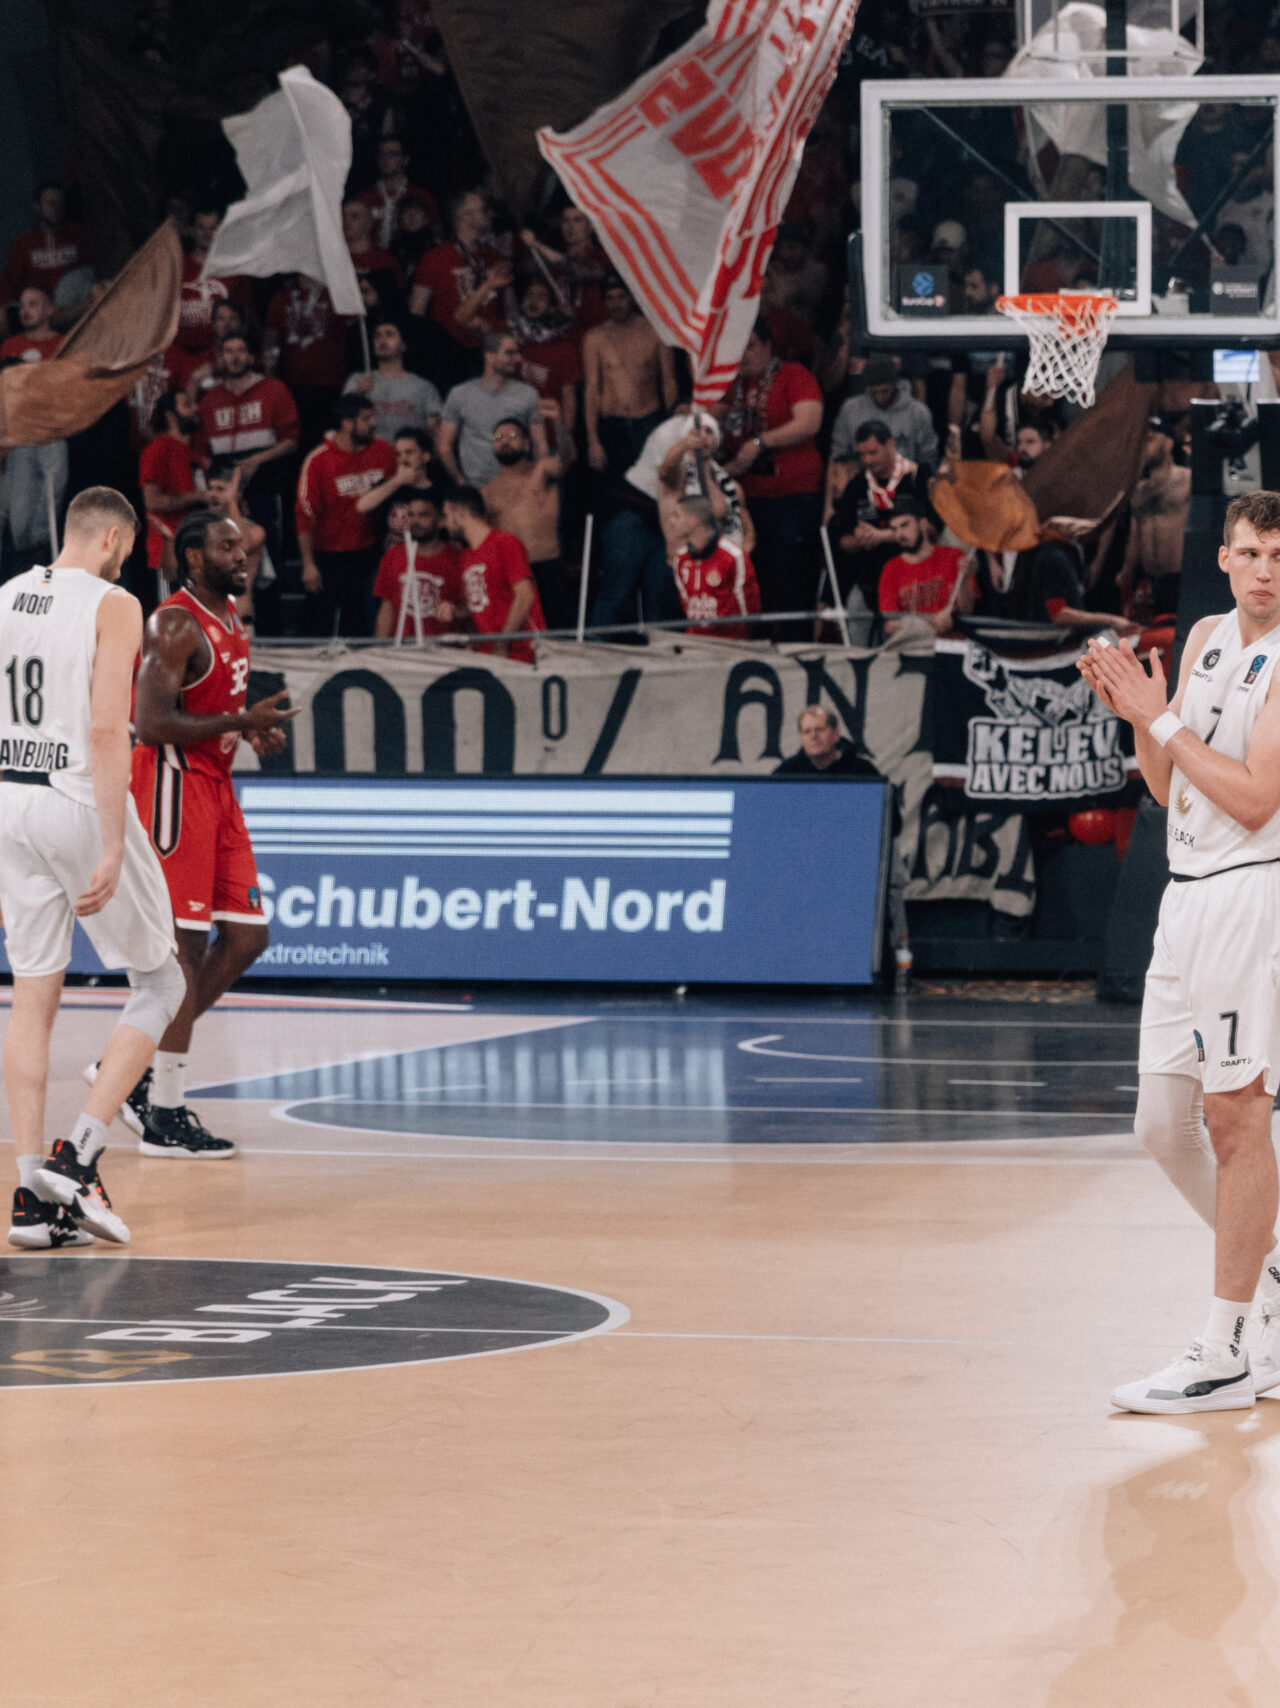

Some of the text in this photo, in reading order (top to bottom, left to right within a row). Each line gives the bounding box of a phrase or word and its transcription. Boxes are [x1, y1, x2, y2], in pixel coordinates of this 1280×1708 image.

[5, 655, 44, 727] 18
[973, 721, 1119, 764] KELEV
[971, 757, 1121, 792] AVEC NOUS
[256, 872, 727, 933] Schubert-Nord
[1219, 1010, 1239, 1057] 7
[1220, 1058, 1247, 1067] CRAFT
[85, 1277, 470, 1344] BLACK
[1232, 1315, 1245, 1345] CRAFT
